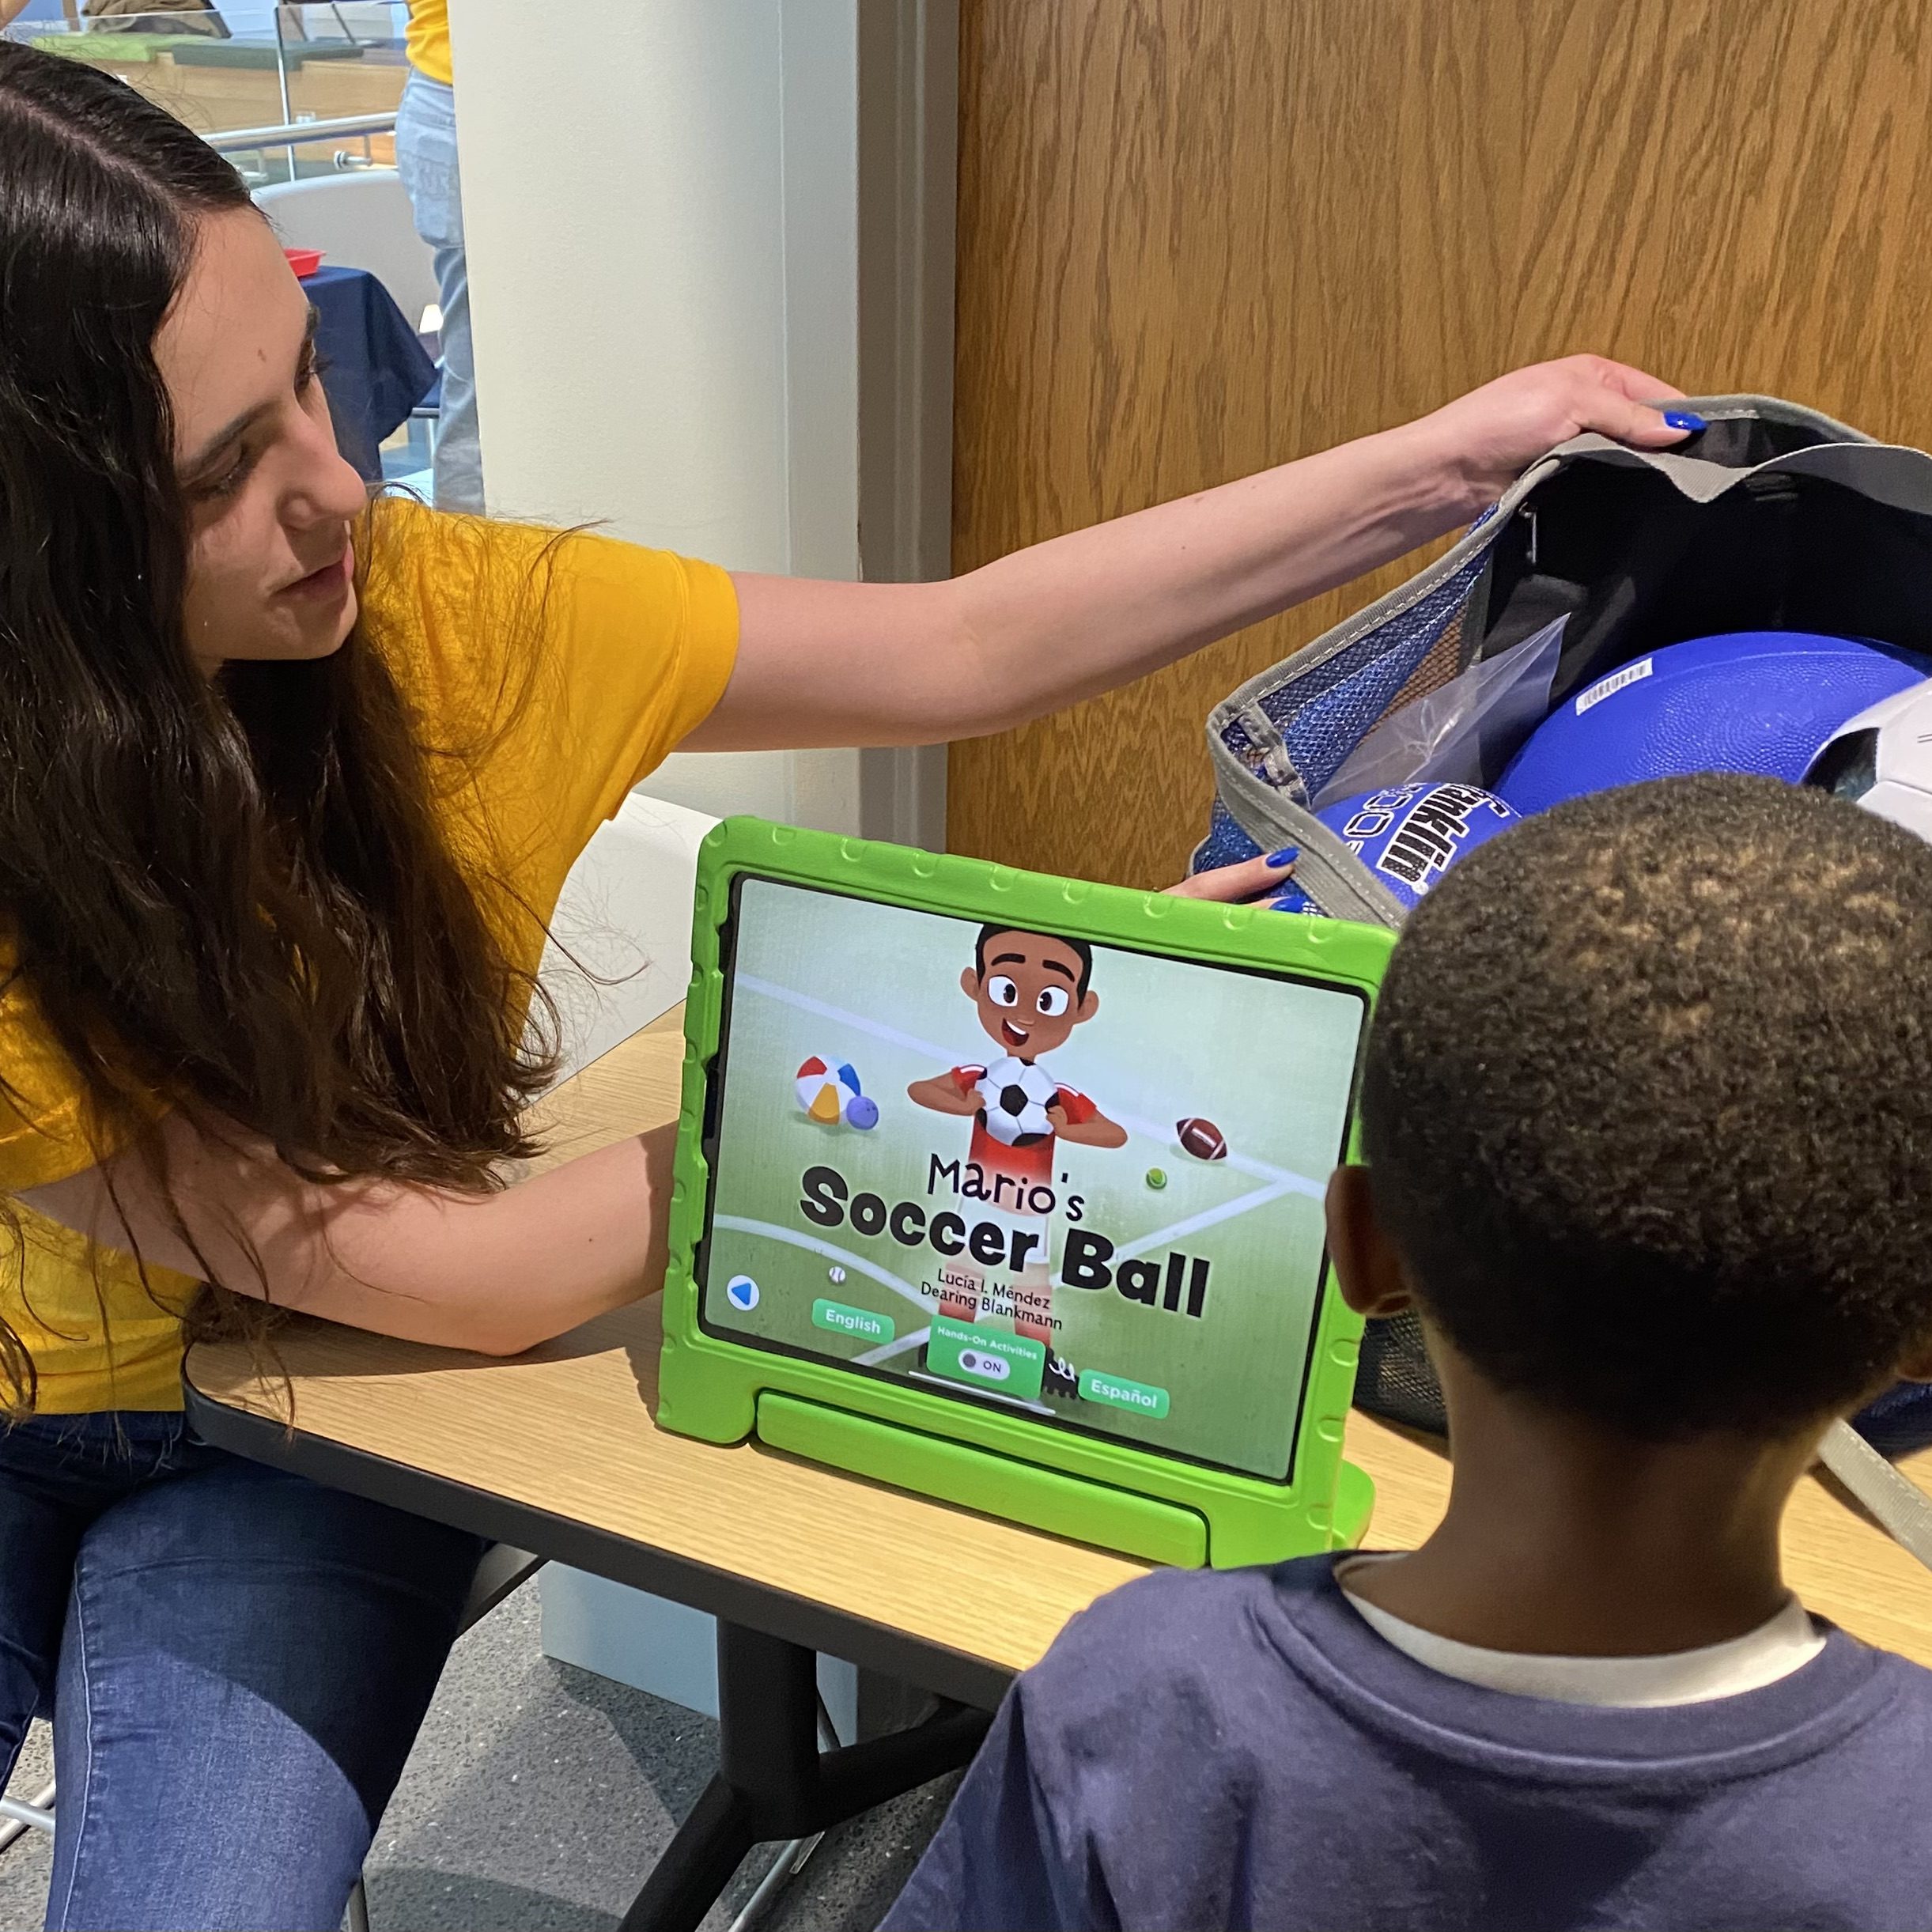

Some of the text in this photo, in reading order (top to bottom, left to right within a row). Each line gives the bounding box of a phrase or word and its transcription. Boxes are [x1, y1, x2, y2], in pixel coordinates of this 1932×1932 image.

[927, 1152, 1086, 1222] Mario's
[800, 1165, 1212, 1318] Soccer Ball
[921, 1281, 1063, 1331] Dearing Blankmann
[937, 1268, 1051, 1310] Lucía I. Méndez
[826, 1308, 881, 1335] English
[937, 1325, 1038, 1361] Hands-On Activities
[982, 1359, 1002, 1374] ON
[1091, 1378, 1158, 1409] Español
